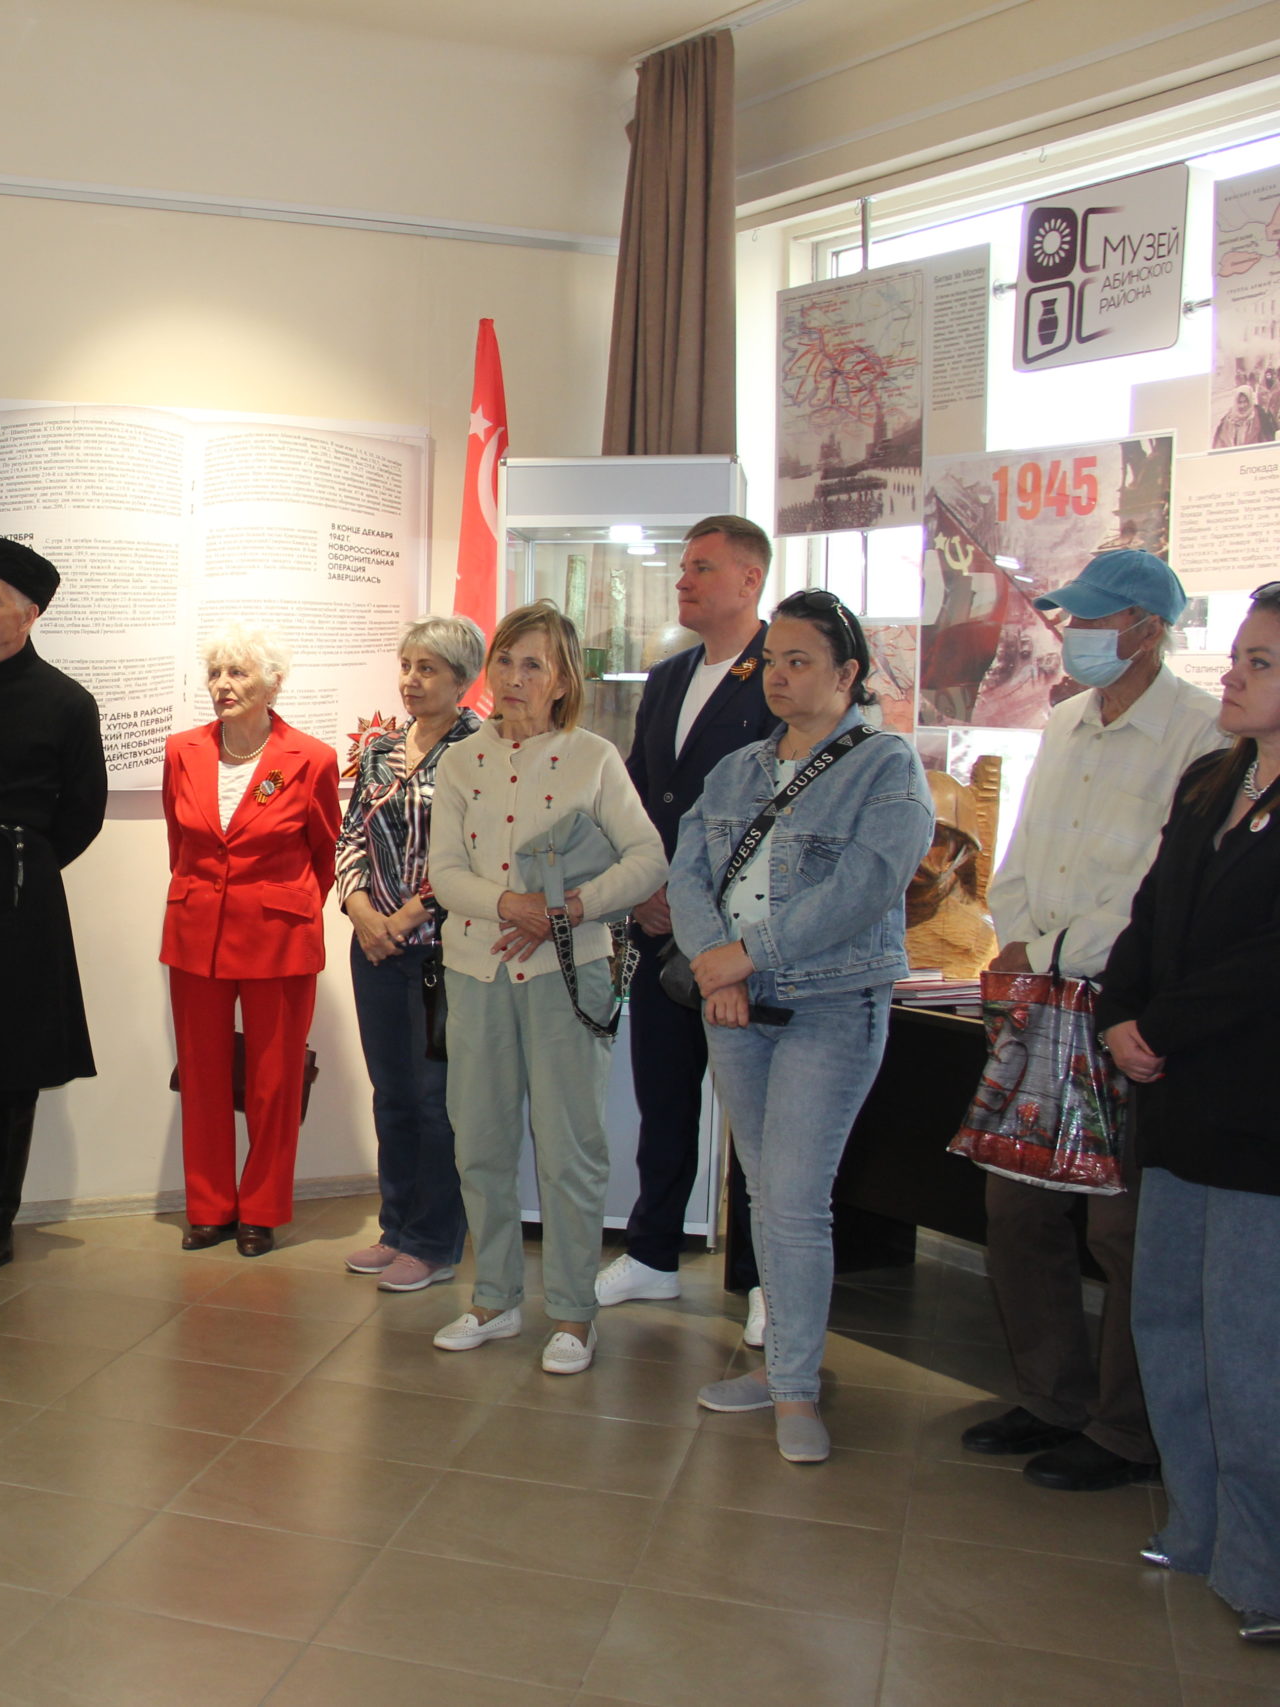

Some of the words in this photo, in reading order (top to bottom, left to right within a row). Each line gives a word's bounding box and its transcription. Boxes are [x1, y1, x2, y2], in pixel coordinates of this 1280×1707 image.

[1102, 226, 1179, 269] МУЗЕЙ
[1099, 284, 1152, 314] РАЙОНА
[1240, 463, 1278, 475] Блокада
[992, 456, 1098, 522] 1945
[329, 533, 345, 542] 1942
[337, 523, 361, 535] КОНЦЕ
[362, 528, 393, 539] ДЕКАБРЯ
[328, 543, 400, 559] НОВОРОССИЙСКАЯ
[328, 553, 395, 567] ОБОРОНИТЕЛЬНАЯ
[328, 563, 366, 573] ОПЕРАЦИЯ
[327, 573, 381, 584] ЗАВЕРШИЛАСЬ
[1184, 664, 1231, 674] Сталингра
[109, 713, 131, 721] ДЕНЬ
[140, 705, 173, 718] РАЙОНЕ
[107, 721, 138, 731] ХУТОРА
[140, 714, 173, 727] ПЕРВЫЙ
[124, 725, 172, 738] ПРОТИВНИК
[121, 734, 172, 750] НЕОБЫЧНЫ
[106, 746, 166, 762] ДЕЙСТВУЮЩИ
[108, 756, 165, 772] ОСЛЕПЛЯЮЩ
[786, 752, 834, 796] GUESS
[726, 827, 762, 879] GUESS
